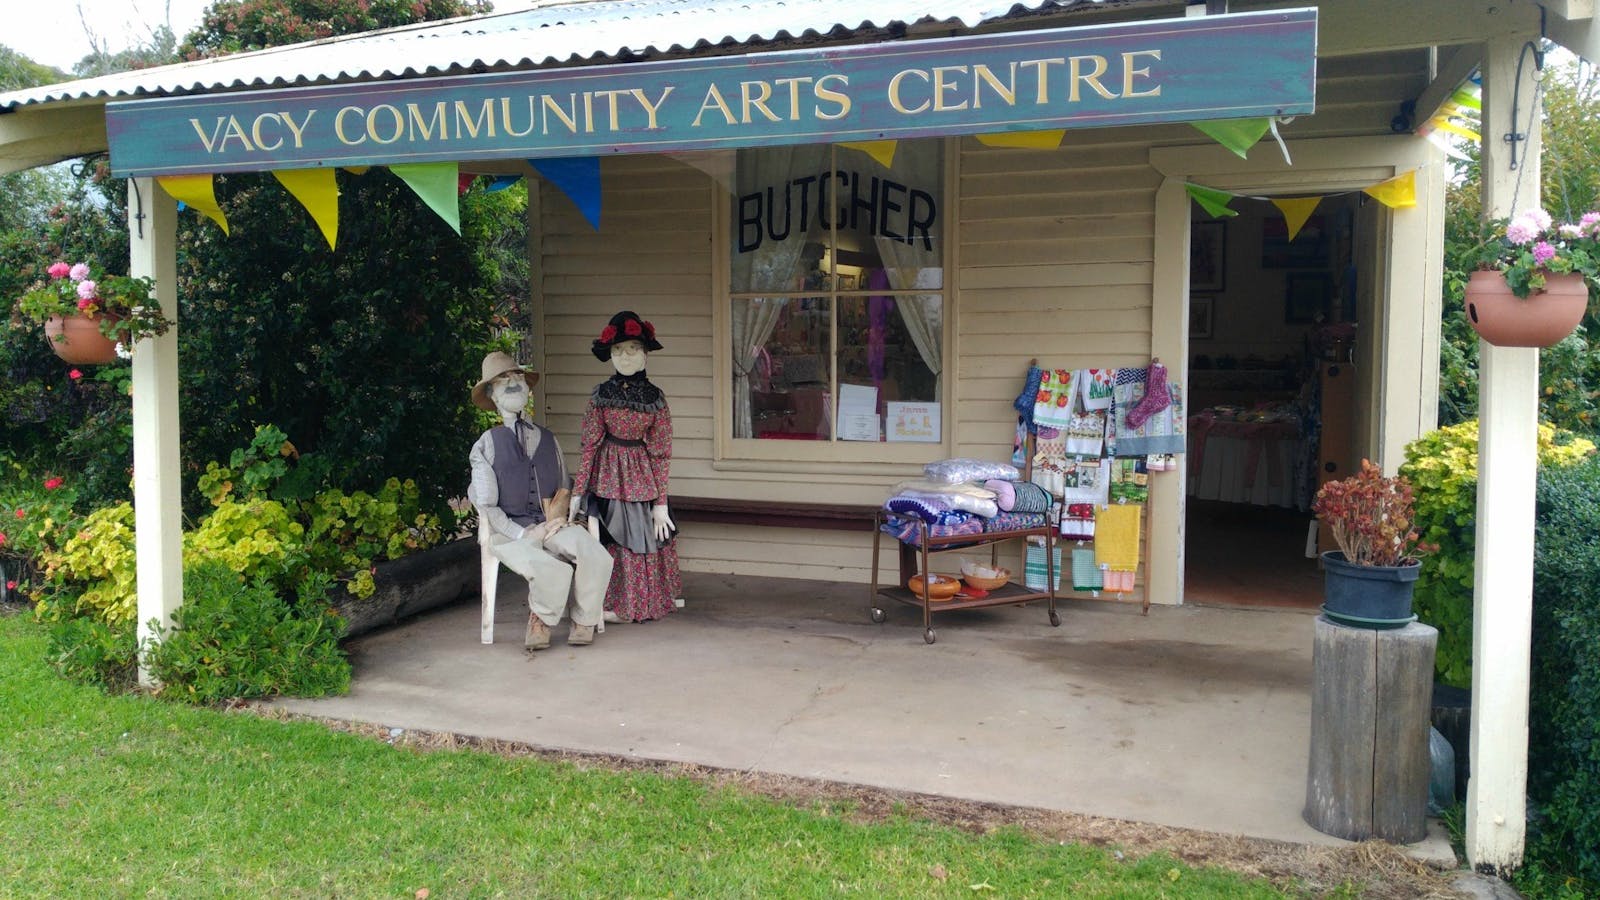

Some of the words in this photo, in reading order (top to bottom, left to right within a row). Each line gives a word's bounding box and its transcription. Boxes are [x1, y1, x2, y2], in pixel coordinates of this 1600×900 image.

[189, 109, 316, 154] VACY
[334, 86, 675, 146] COMMUNITY
[692, 74, 852, 127] ARTS
[888, 49, 1162, 115] CENTRE
[738, 170, 936, 254] BUTCHER
